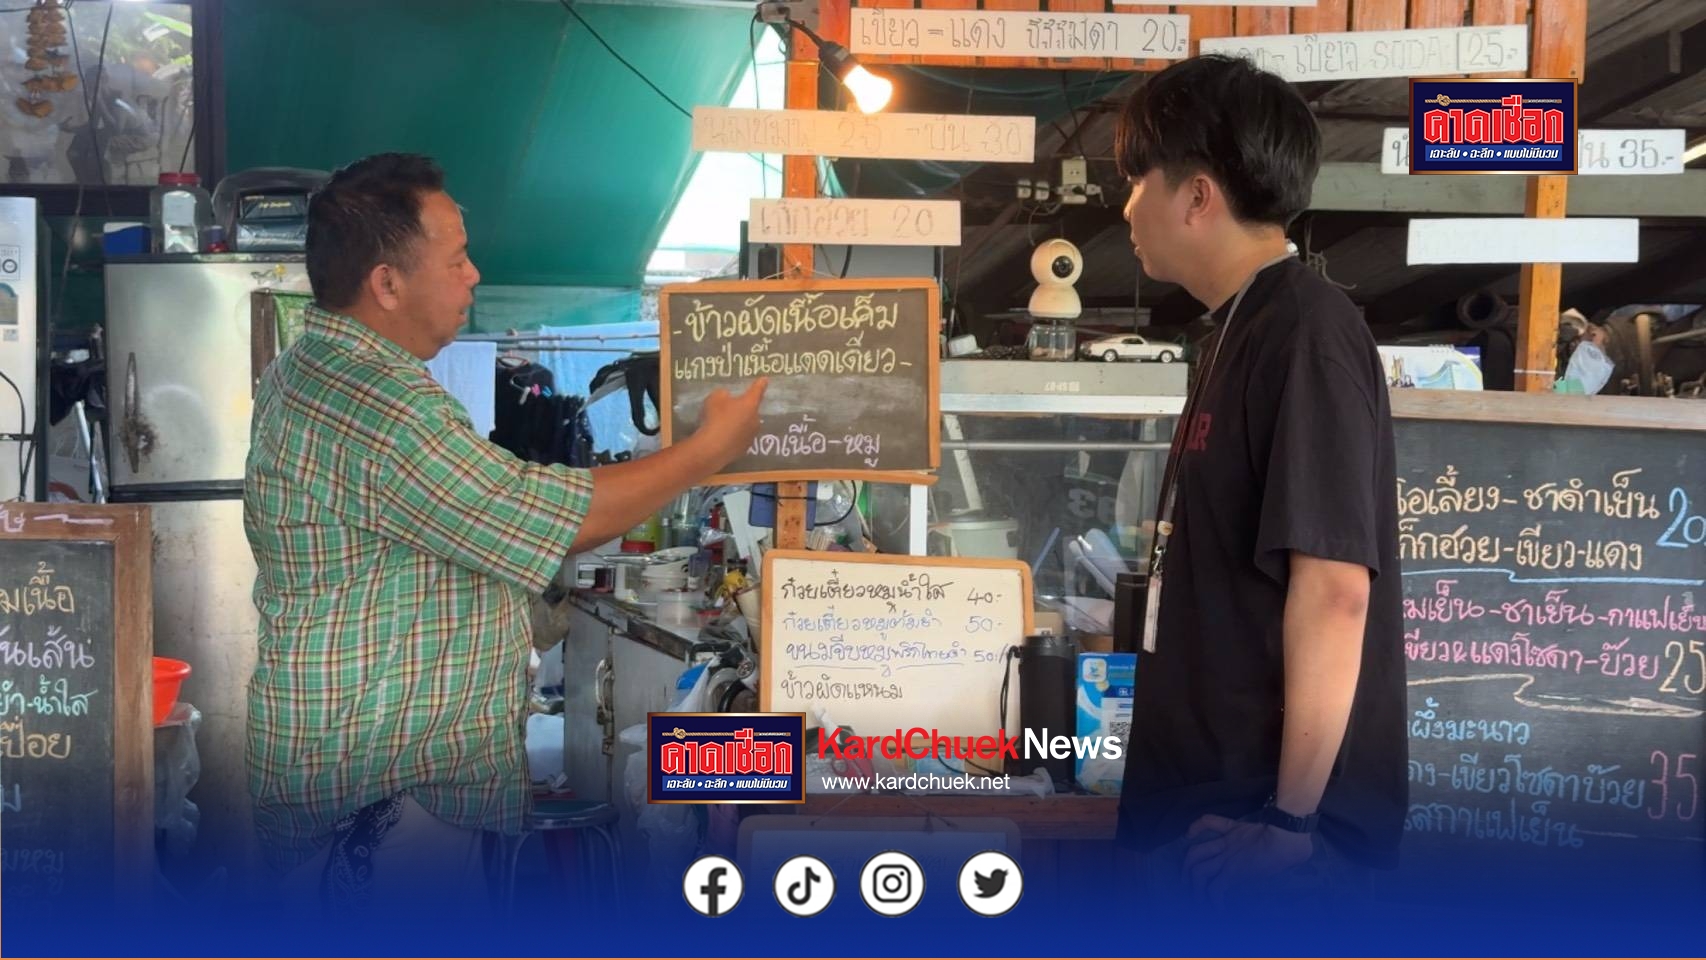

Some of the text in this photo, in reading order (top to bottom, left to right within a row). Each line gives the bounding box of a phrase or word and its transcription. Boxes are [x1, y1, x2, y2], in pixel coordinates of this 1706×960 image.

[1026, 18, 1119, 50] ธรรมดา
[892, 205, 934, 239] 20
[1406, 696, 1531, 746] ผึ้งมะนาว
